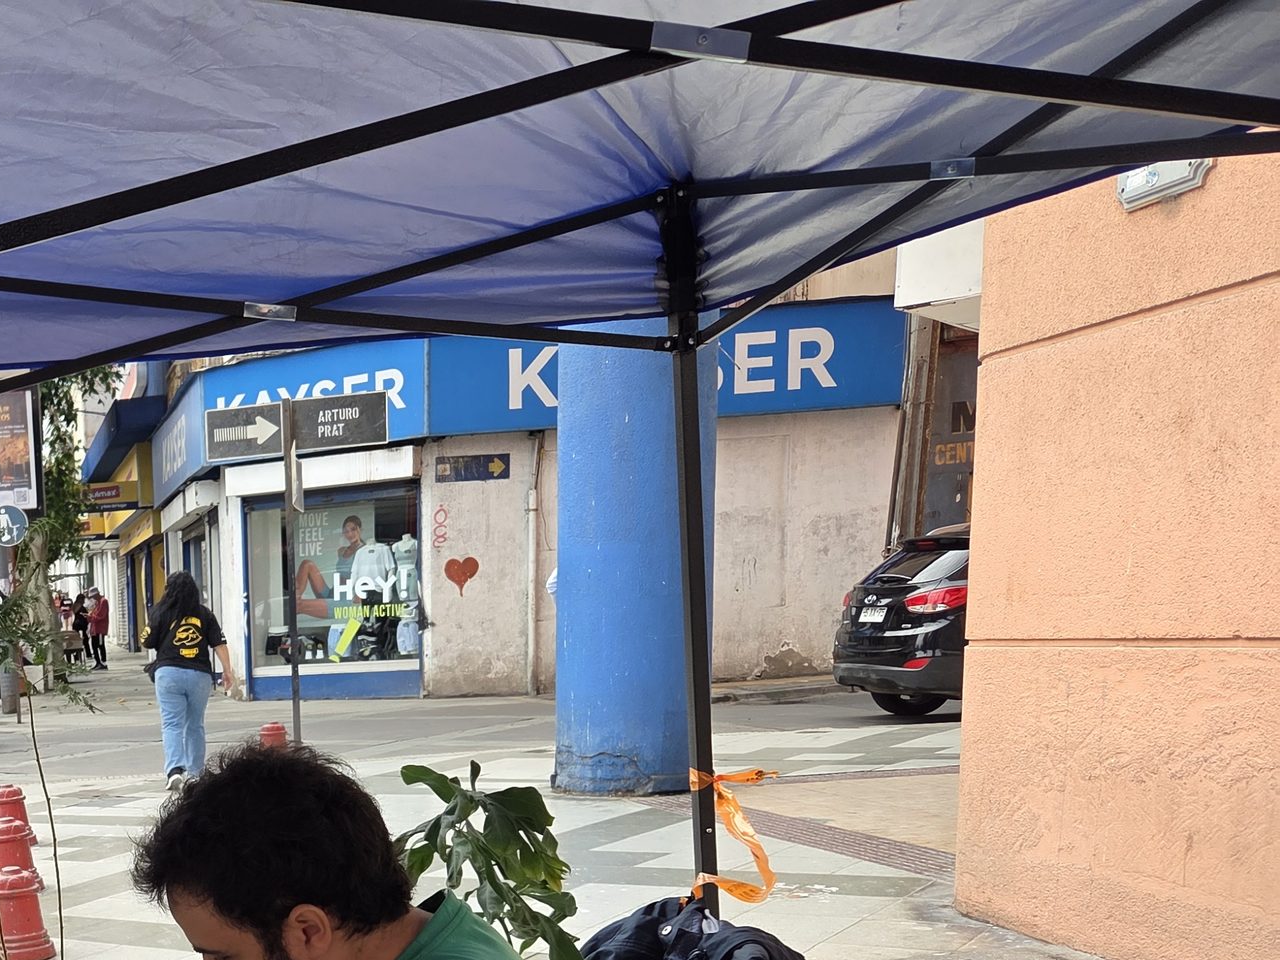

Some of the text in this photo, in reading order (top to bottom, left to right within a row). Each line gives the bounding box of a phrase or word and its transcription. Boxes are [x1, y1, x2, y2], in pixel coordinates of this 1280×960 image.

[508, 326, 838, 410] KER
[317, 406, 360, 424] ARTURO
[317, 423, 345, 438] PRAT
[299, 512, 329, 528] MOVE
[299, 527, 325, 543] FEEL
[299, 542, 323, 557] LIVE
[333, 603, 408, 619] WOMAN ACTIVE
